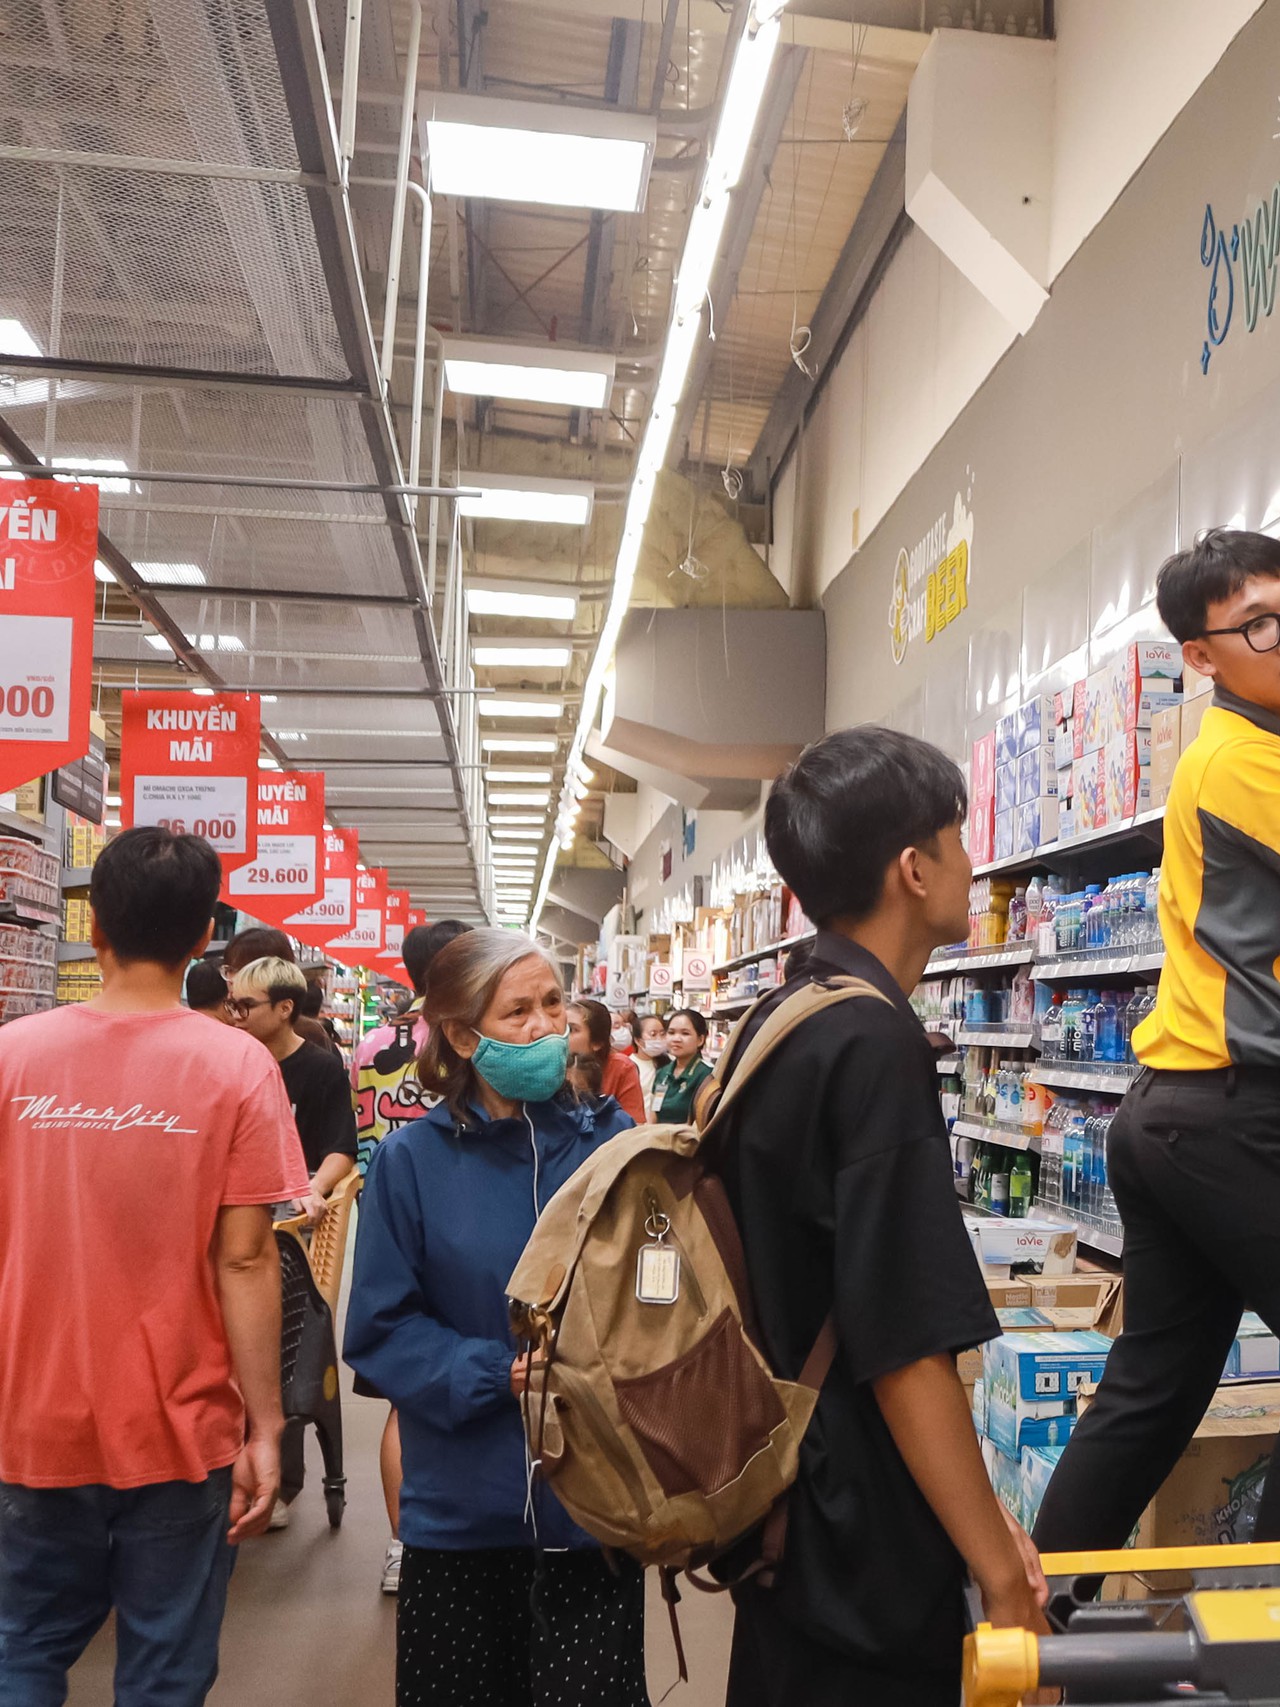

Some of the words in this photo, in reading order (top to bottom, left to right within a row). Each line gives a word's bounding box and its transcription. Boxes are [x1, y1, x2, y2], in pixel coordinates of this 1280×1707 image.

[926, 538, 968, 644] BEER
[1146, 650, 1171, 660] laVie
[0, 685, 55, 719] 00
[147, 703, 237, 731] KHUYẾN
[169, 736, 213, 763] MÃI
[257, 804, 289, 825] MÃI
[248, 867, 309, 883] 29.600
[1016, 1236, 1043, 1246] laVie
